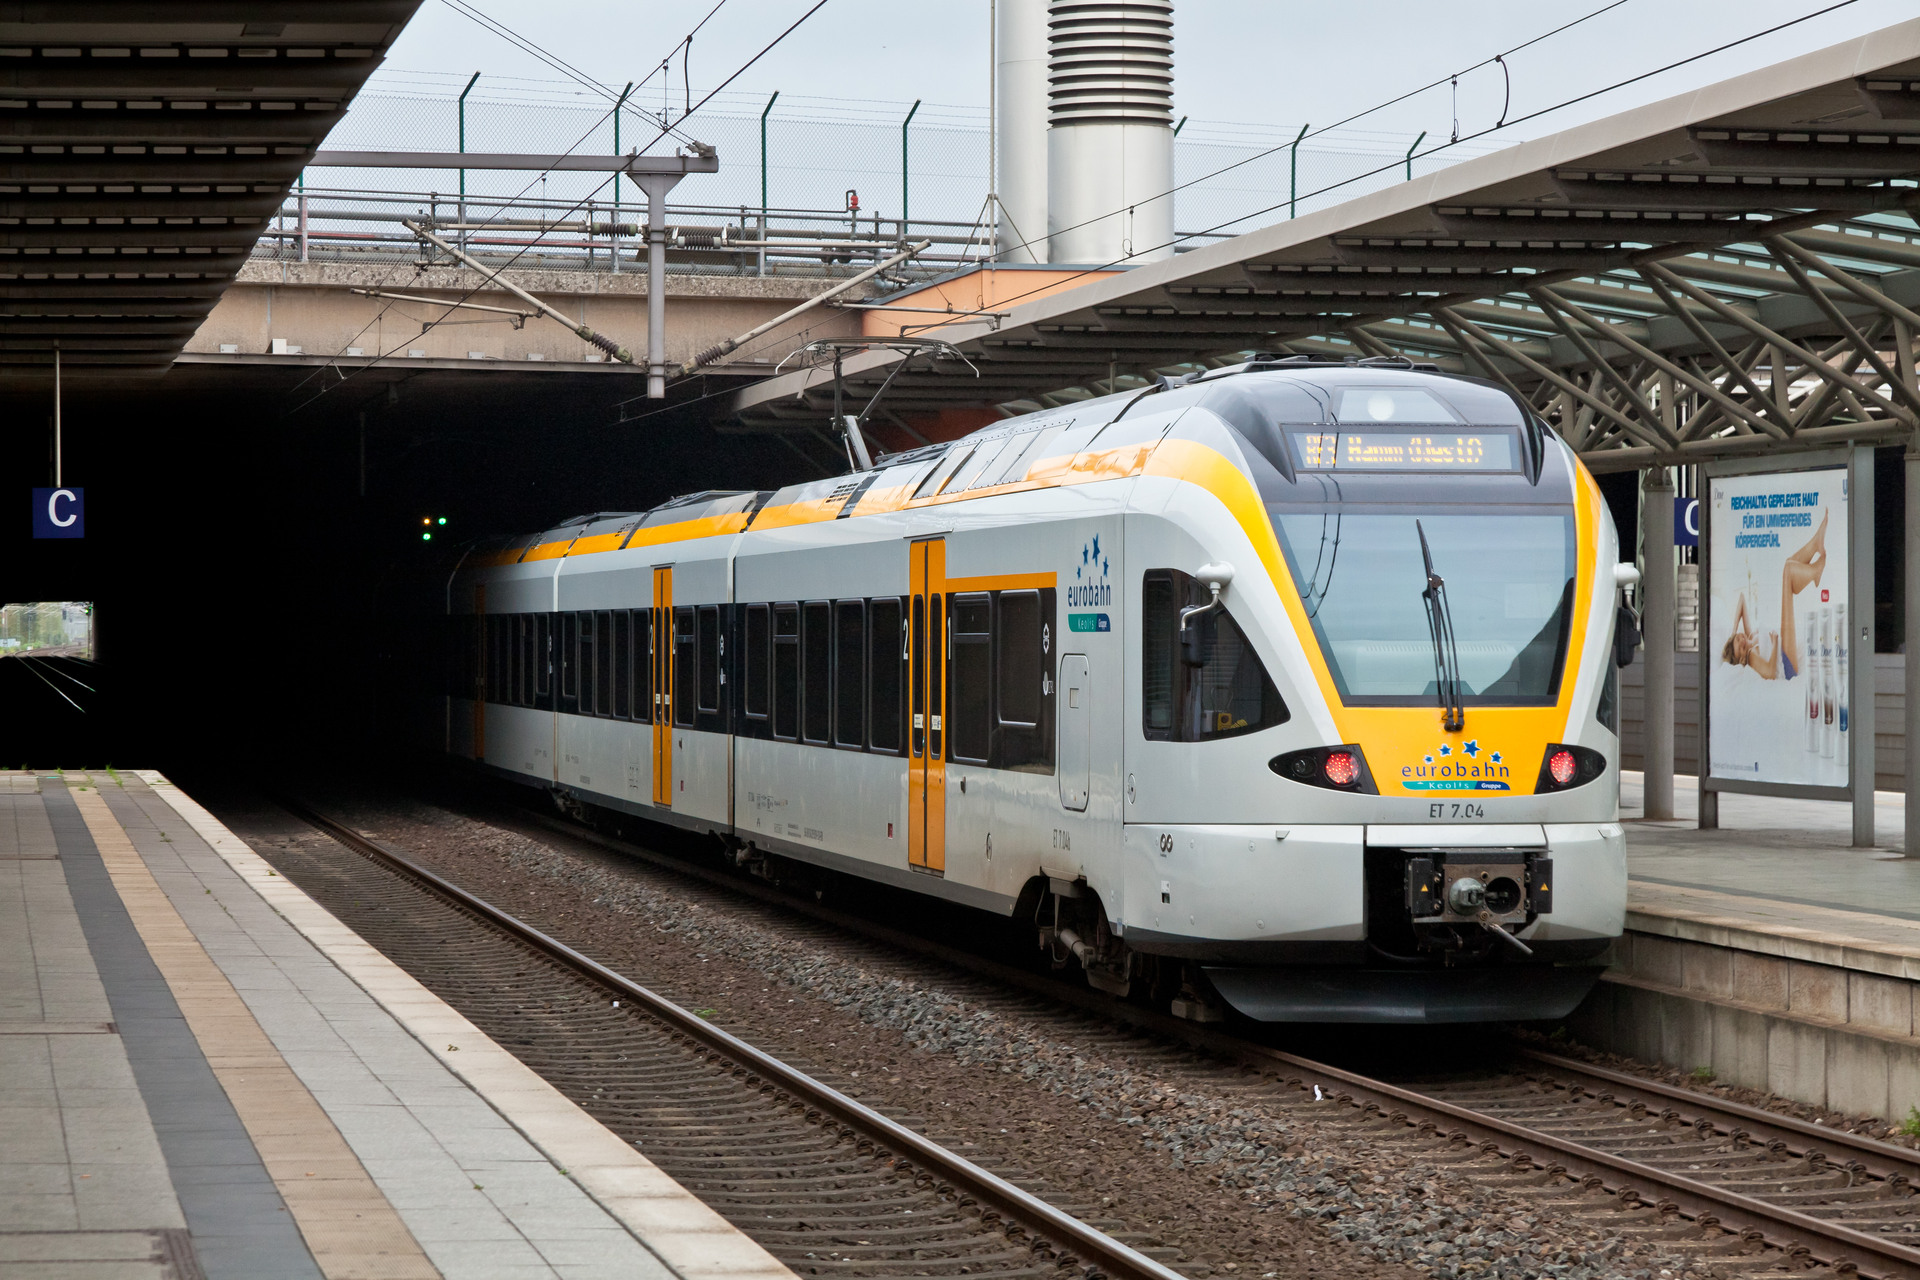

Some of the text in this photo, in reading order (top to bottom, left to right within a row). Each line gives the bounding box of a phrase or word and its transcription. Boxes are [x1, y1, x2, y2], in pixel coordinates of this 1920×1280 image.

[48, 489, 77, 527] C
[1730, 491, 1819, 510] REICHHALTIG GEPFLEGTE HAUT
[1742, 511, 1812, 529] FÜR EIN UMWERFENDES
[1735, 529, 1780, 549] KÖRPERGEFÜHL
[1067, 575, 1111, 607] eurobahn
[903, 618, 909, 660] 2
[1401, 761, 1510, 777] eurobahn
[1480, 782, 1502, 790] Gruppe
[1429, 803, 1484, 819] ET 7.04
